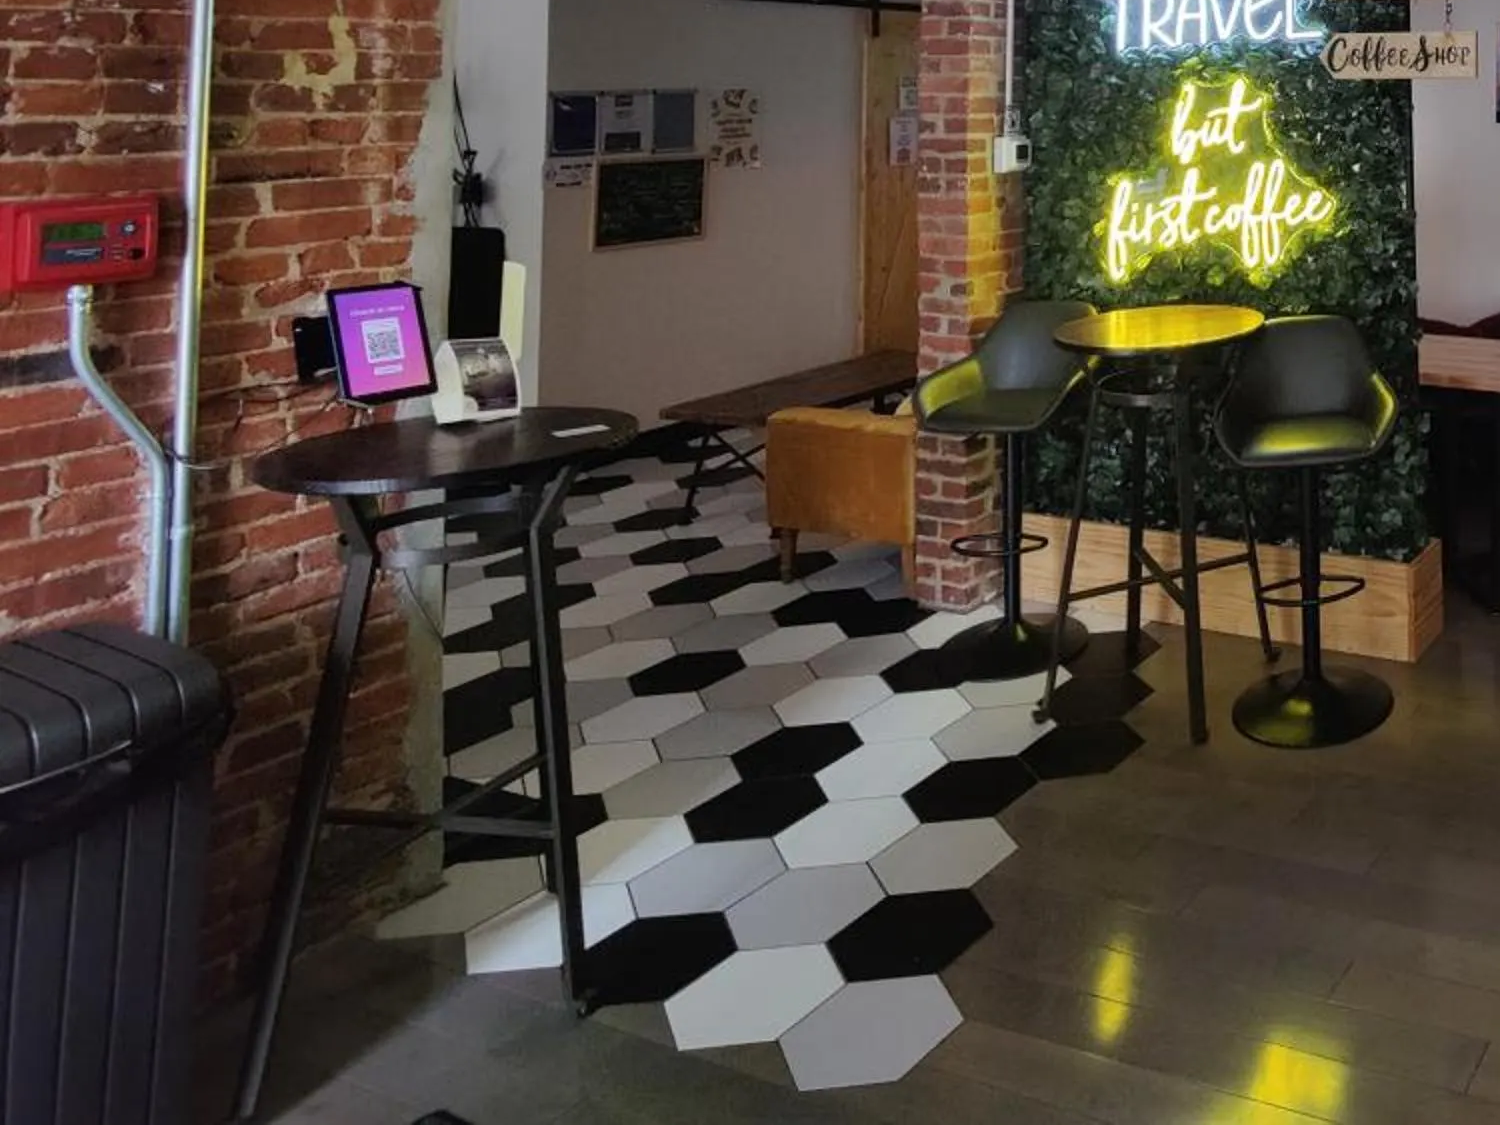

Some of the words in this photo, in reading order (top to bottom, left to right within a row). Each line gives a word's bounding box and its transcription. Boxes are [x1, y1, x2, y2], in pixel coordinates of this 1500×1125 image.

[1171, 77, 1263, 165] but
[1107, 167, 1217, 280] first
[1204, 158, 1333, 267] coffee
